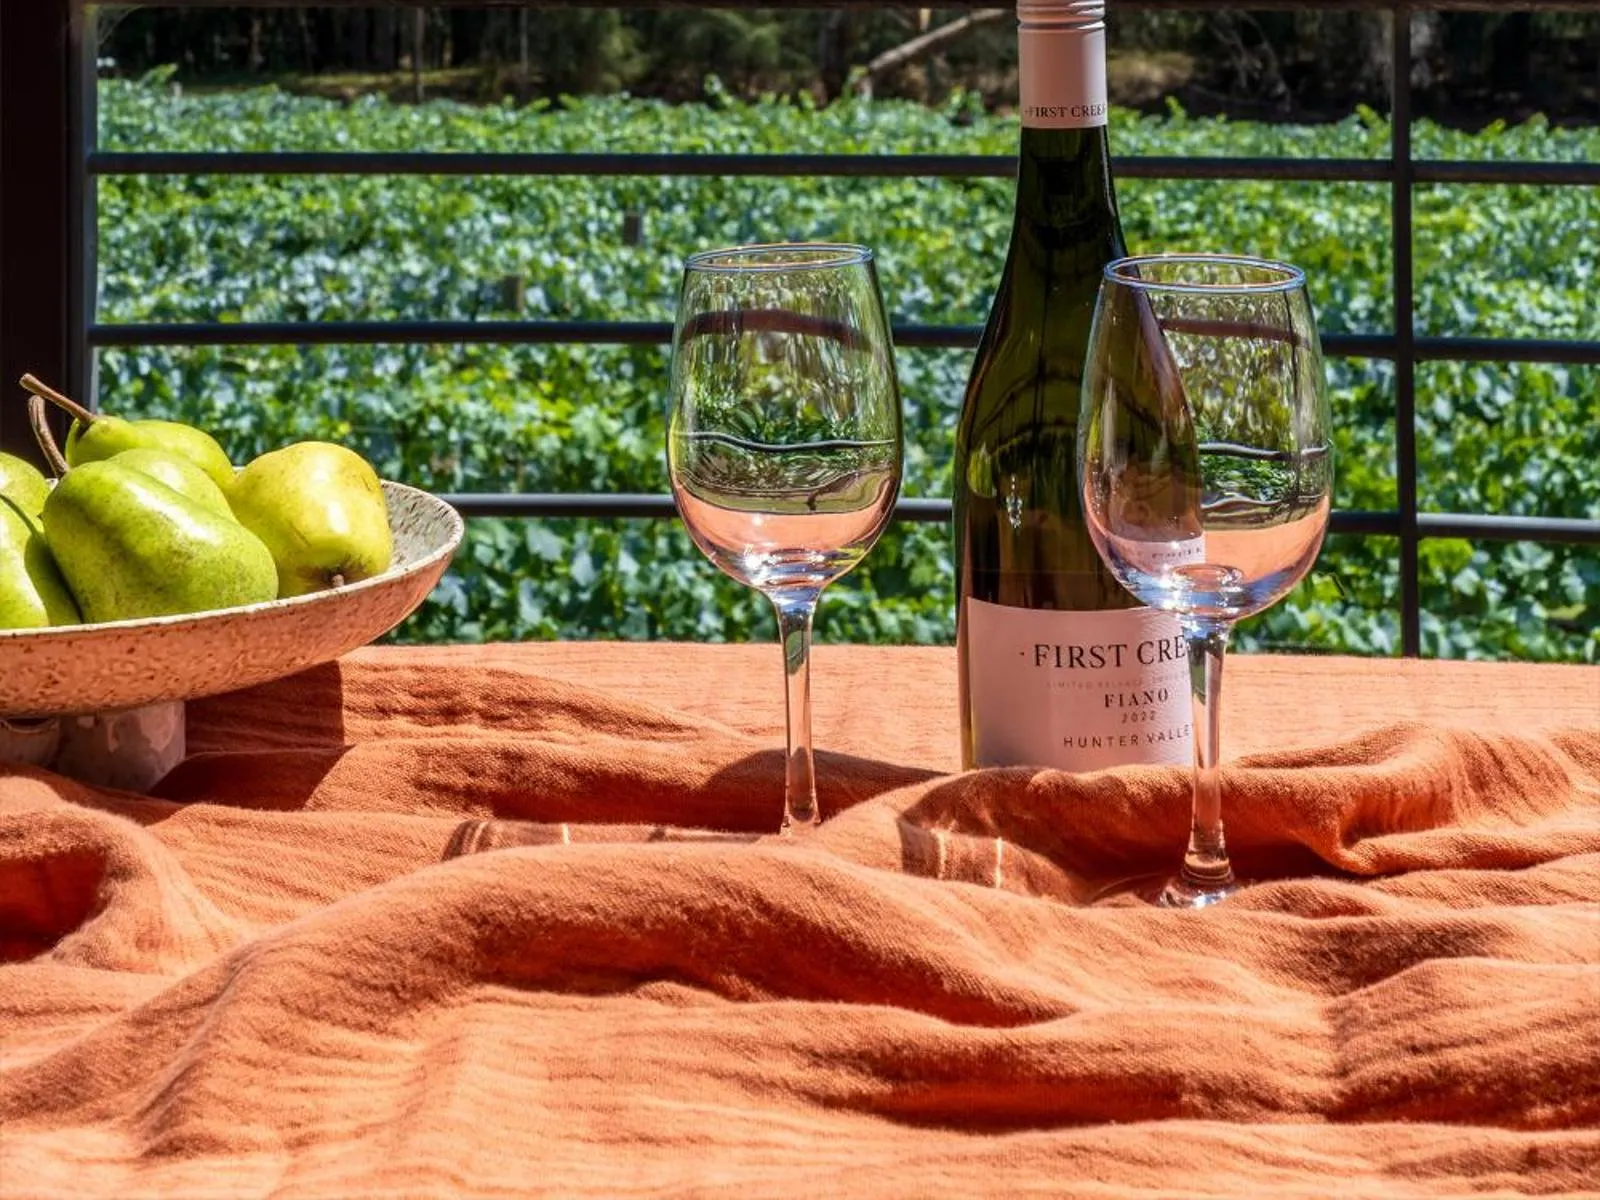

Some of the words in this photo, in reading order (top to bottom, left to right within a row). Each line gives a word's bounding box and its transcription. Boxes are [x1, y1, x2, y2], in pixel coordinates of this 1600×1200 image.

[1028, 104, 1067, 118] FIRST
[1034, 643, 1127, 669] FIRST
[1137, 635, 1187, 665] CRE
[1104, 687, 1169, 708] FIANO
[1121, 710, 1156, 724] 2022
[1063, 735, 1139, 748] HUNTER
[1146, 724, 1192, 744] VALLE
